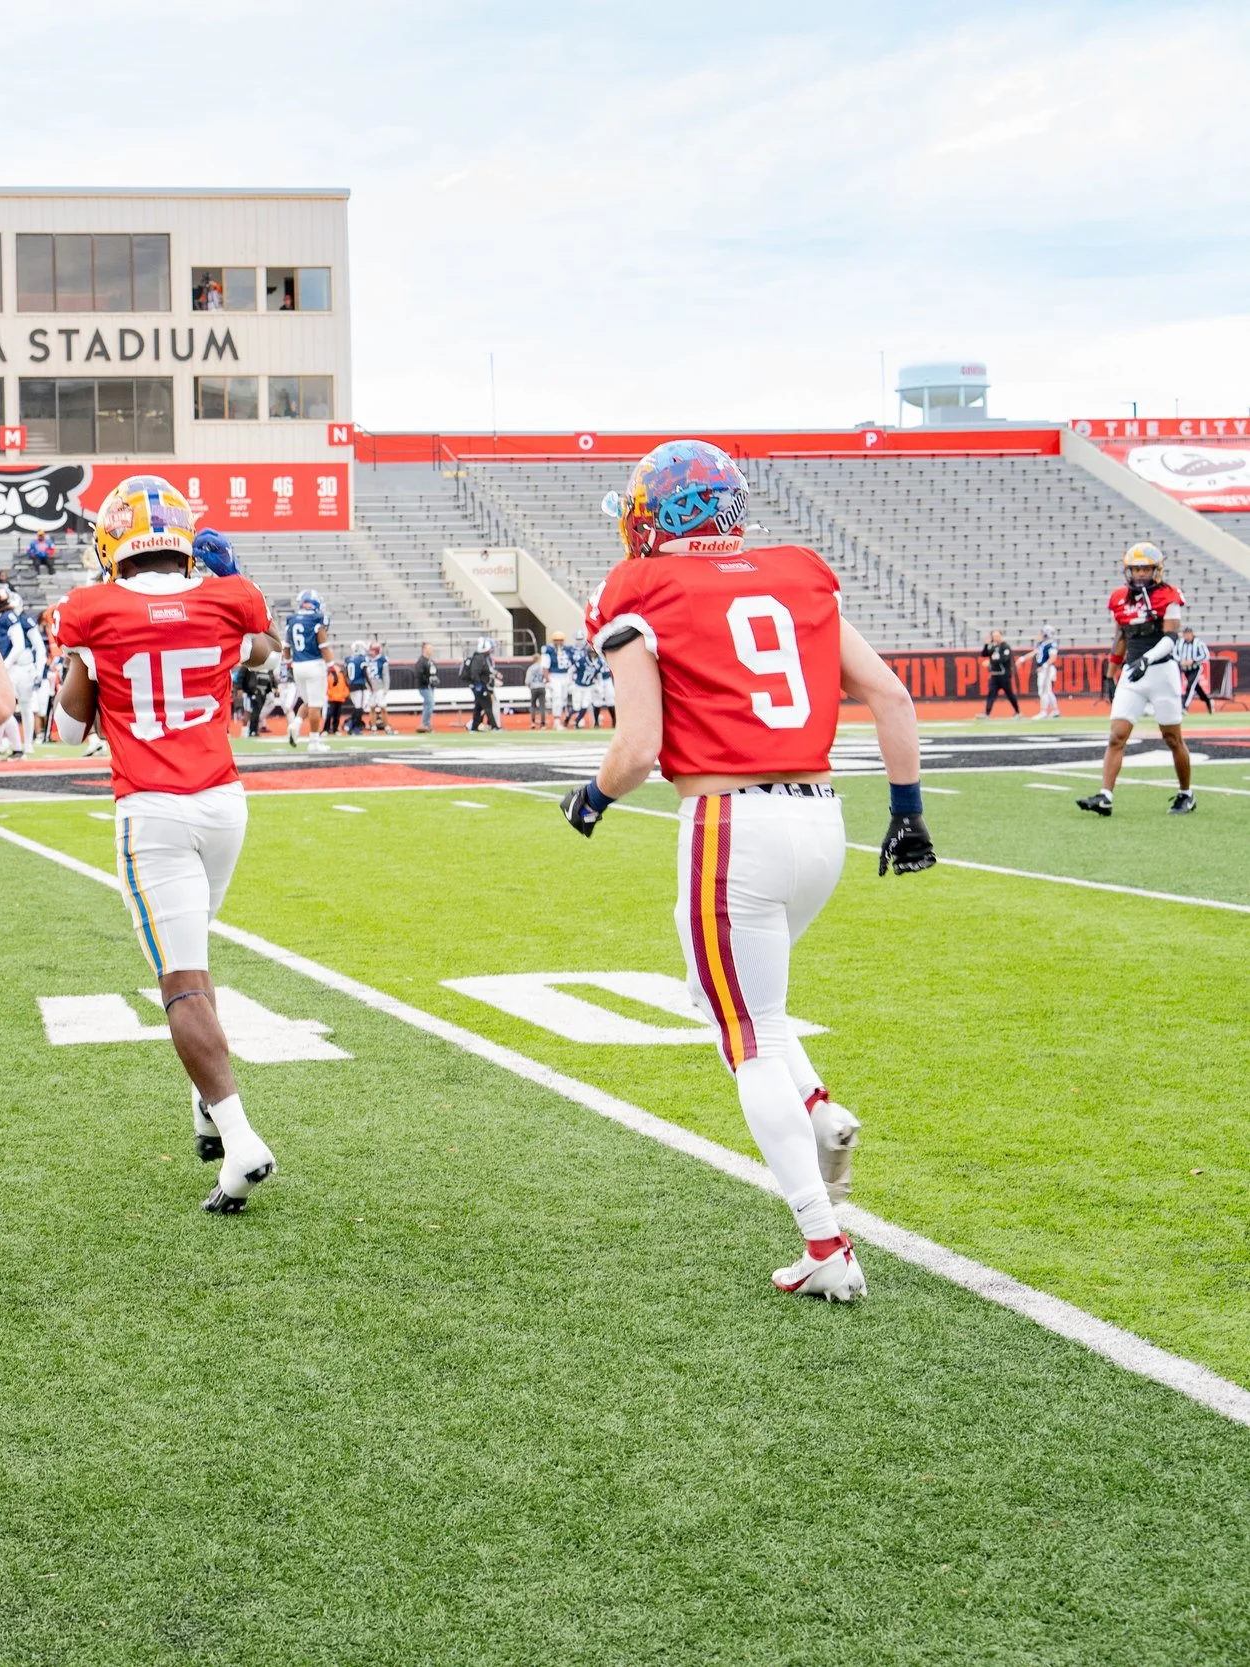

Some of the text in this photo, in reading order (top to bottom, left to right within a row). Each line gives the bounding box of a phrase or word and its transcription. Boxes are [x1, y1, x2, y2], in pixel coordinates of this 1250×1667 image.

[29, 327, 239, 363] STADIUM
[333, 426, 348, 443] N
[1104, 420, 1247, 436] THE CITY
[5, 429, 21, 446] M
[578, 434, 594, 451] O
[865, 431, 878, 448] P
[229, 477, 247, 498] 10
[272, 476, 294, 498] 46
[317, 476, 338, 497] 30
[131, 536, 181, 551] Riddell
[688, 540, 740, 552] Riddell
[472, 564, 515, 576] noodles
[292, 622, 306, 652] 6
[726, 594, 811, 730] 9
